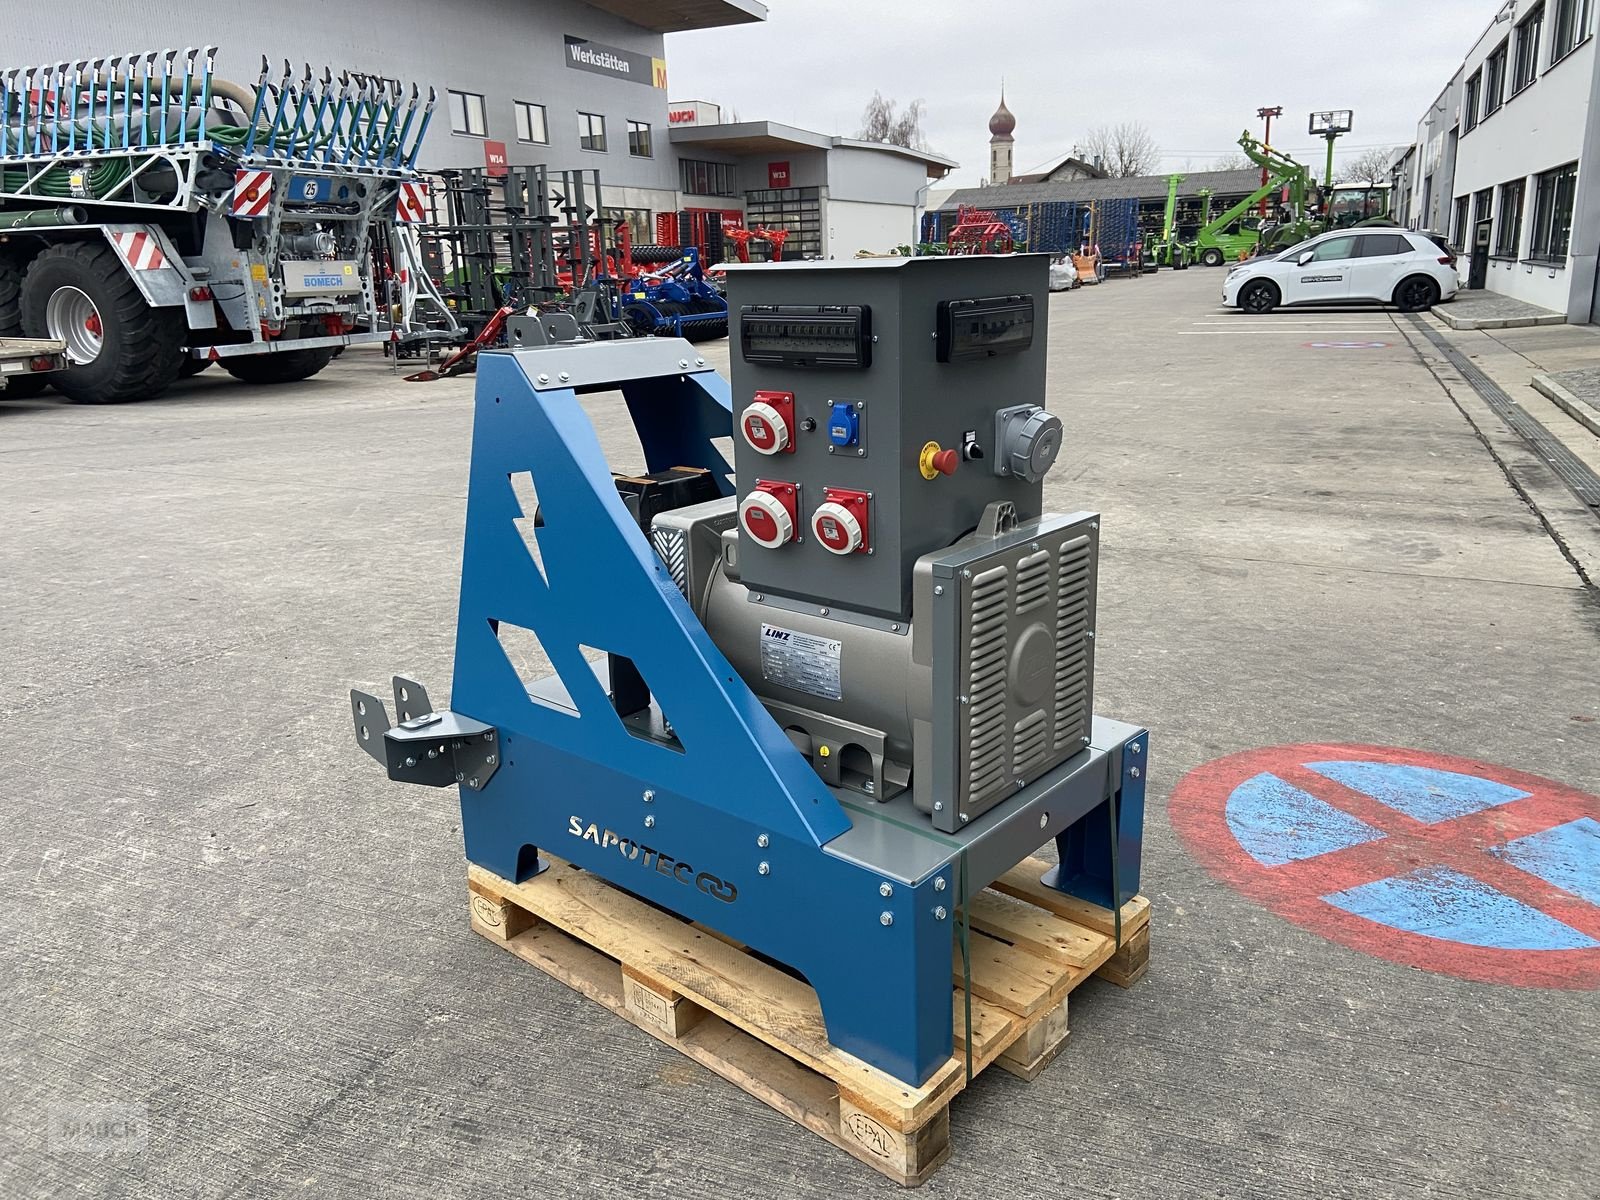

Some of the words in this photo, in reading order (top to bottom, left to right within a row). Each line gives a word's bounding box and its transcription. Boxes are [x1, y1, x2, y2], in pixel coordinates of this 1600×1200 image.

[570, 44, 630, 73] Werkstätten
[656, 67, 668, 89] M
[489, 153, 504, 164] W14
[772, 171, 787, 179] W13
[306, 183, 316, 196] 25
[303, 277, 343, 287] BOMECH
[765, 628, 791, 641] LINZ
[568, 815, 694, 885] SAPOTEC
[856, 1118, 891, 1155] EPAL
